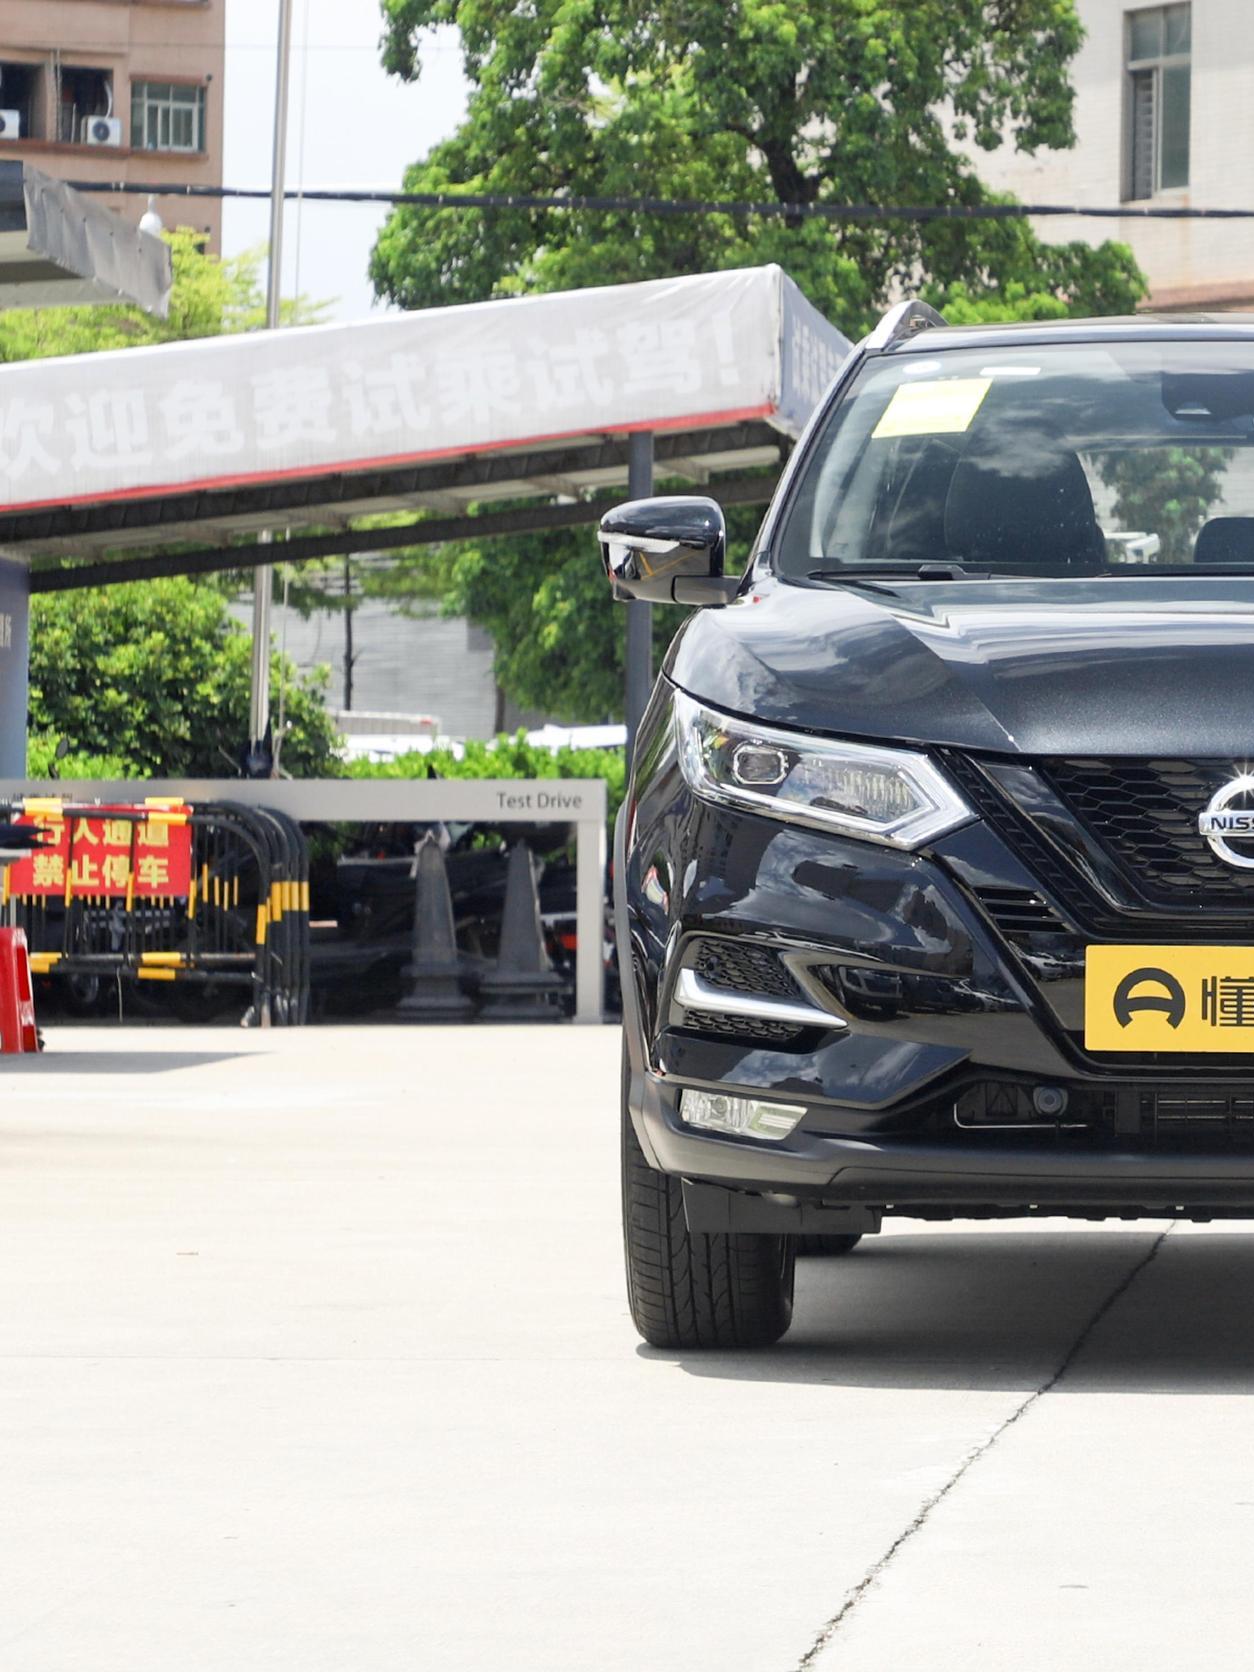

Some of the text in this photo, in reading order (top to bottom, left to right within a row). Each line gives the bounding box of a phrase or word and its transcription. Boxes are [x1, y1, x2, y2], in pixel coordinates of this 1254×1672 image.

[496, 791, 583, 809] Test Drive
[32, 853, 169, 889] 禁止停车
